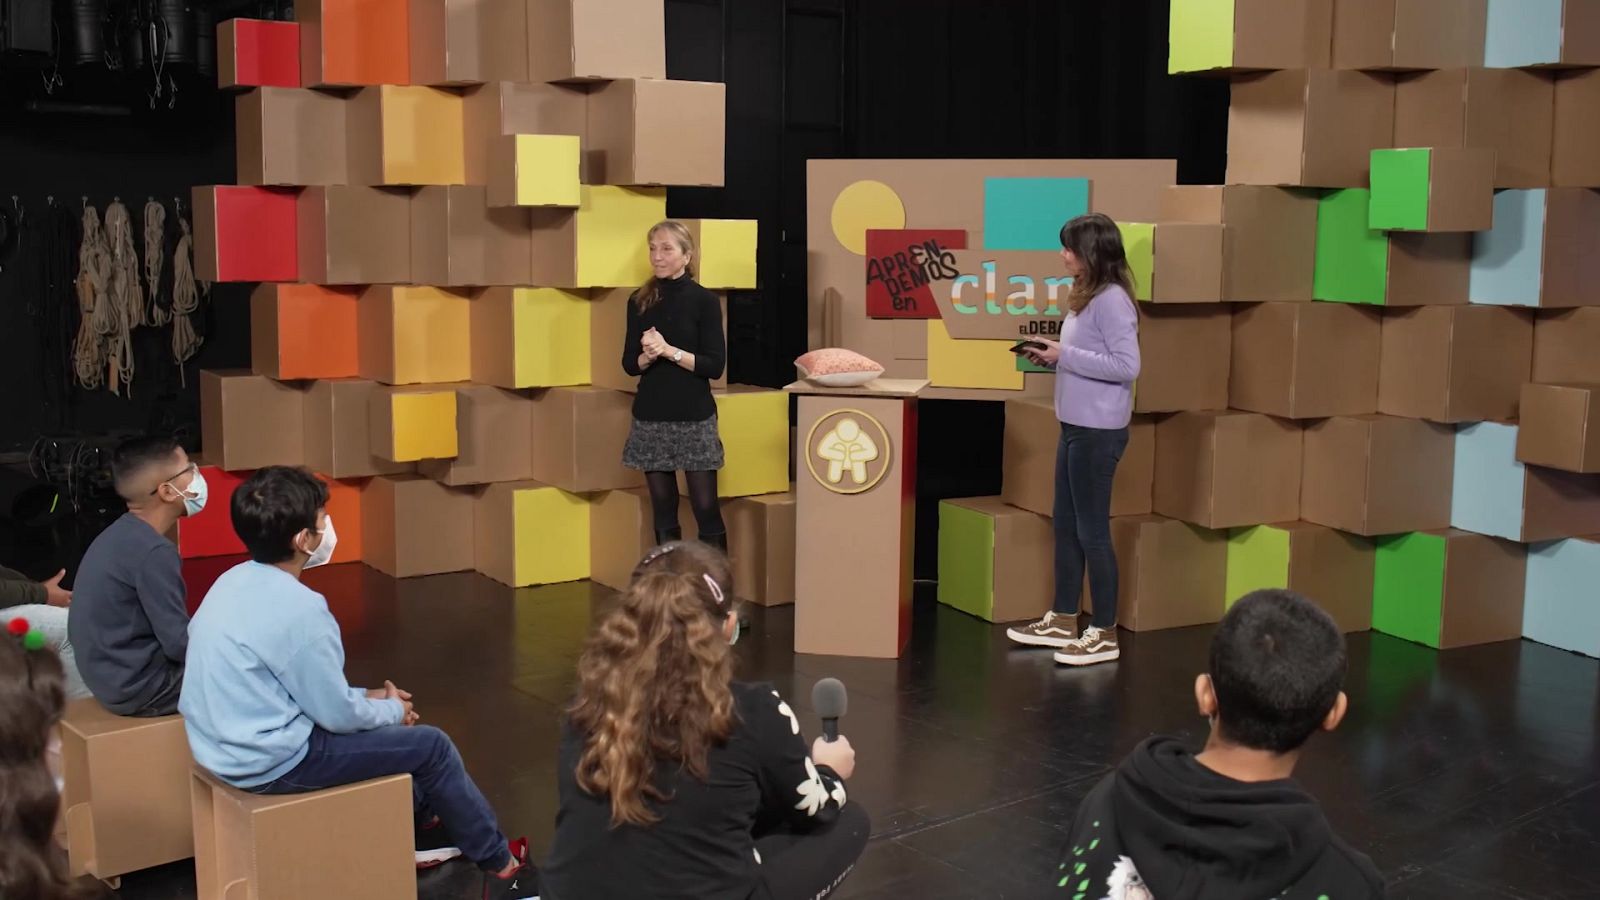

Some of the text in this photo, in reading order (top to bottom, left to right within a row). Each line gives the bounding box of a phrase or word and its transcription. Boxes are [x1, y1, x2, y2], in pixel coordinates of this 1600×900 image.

[883, 252, 960, 297] DEMOS
[892, 294, 917, 311] en
[1019, 325, 1028, 335] EL
